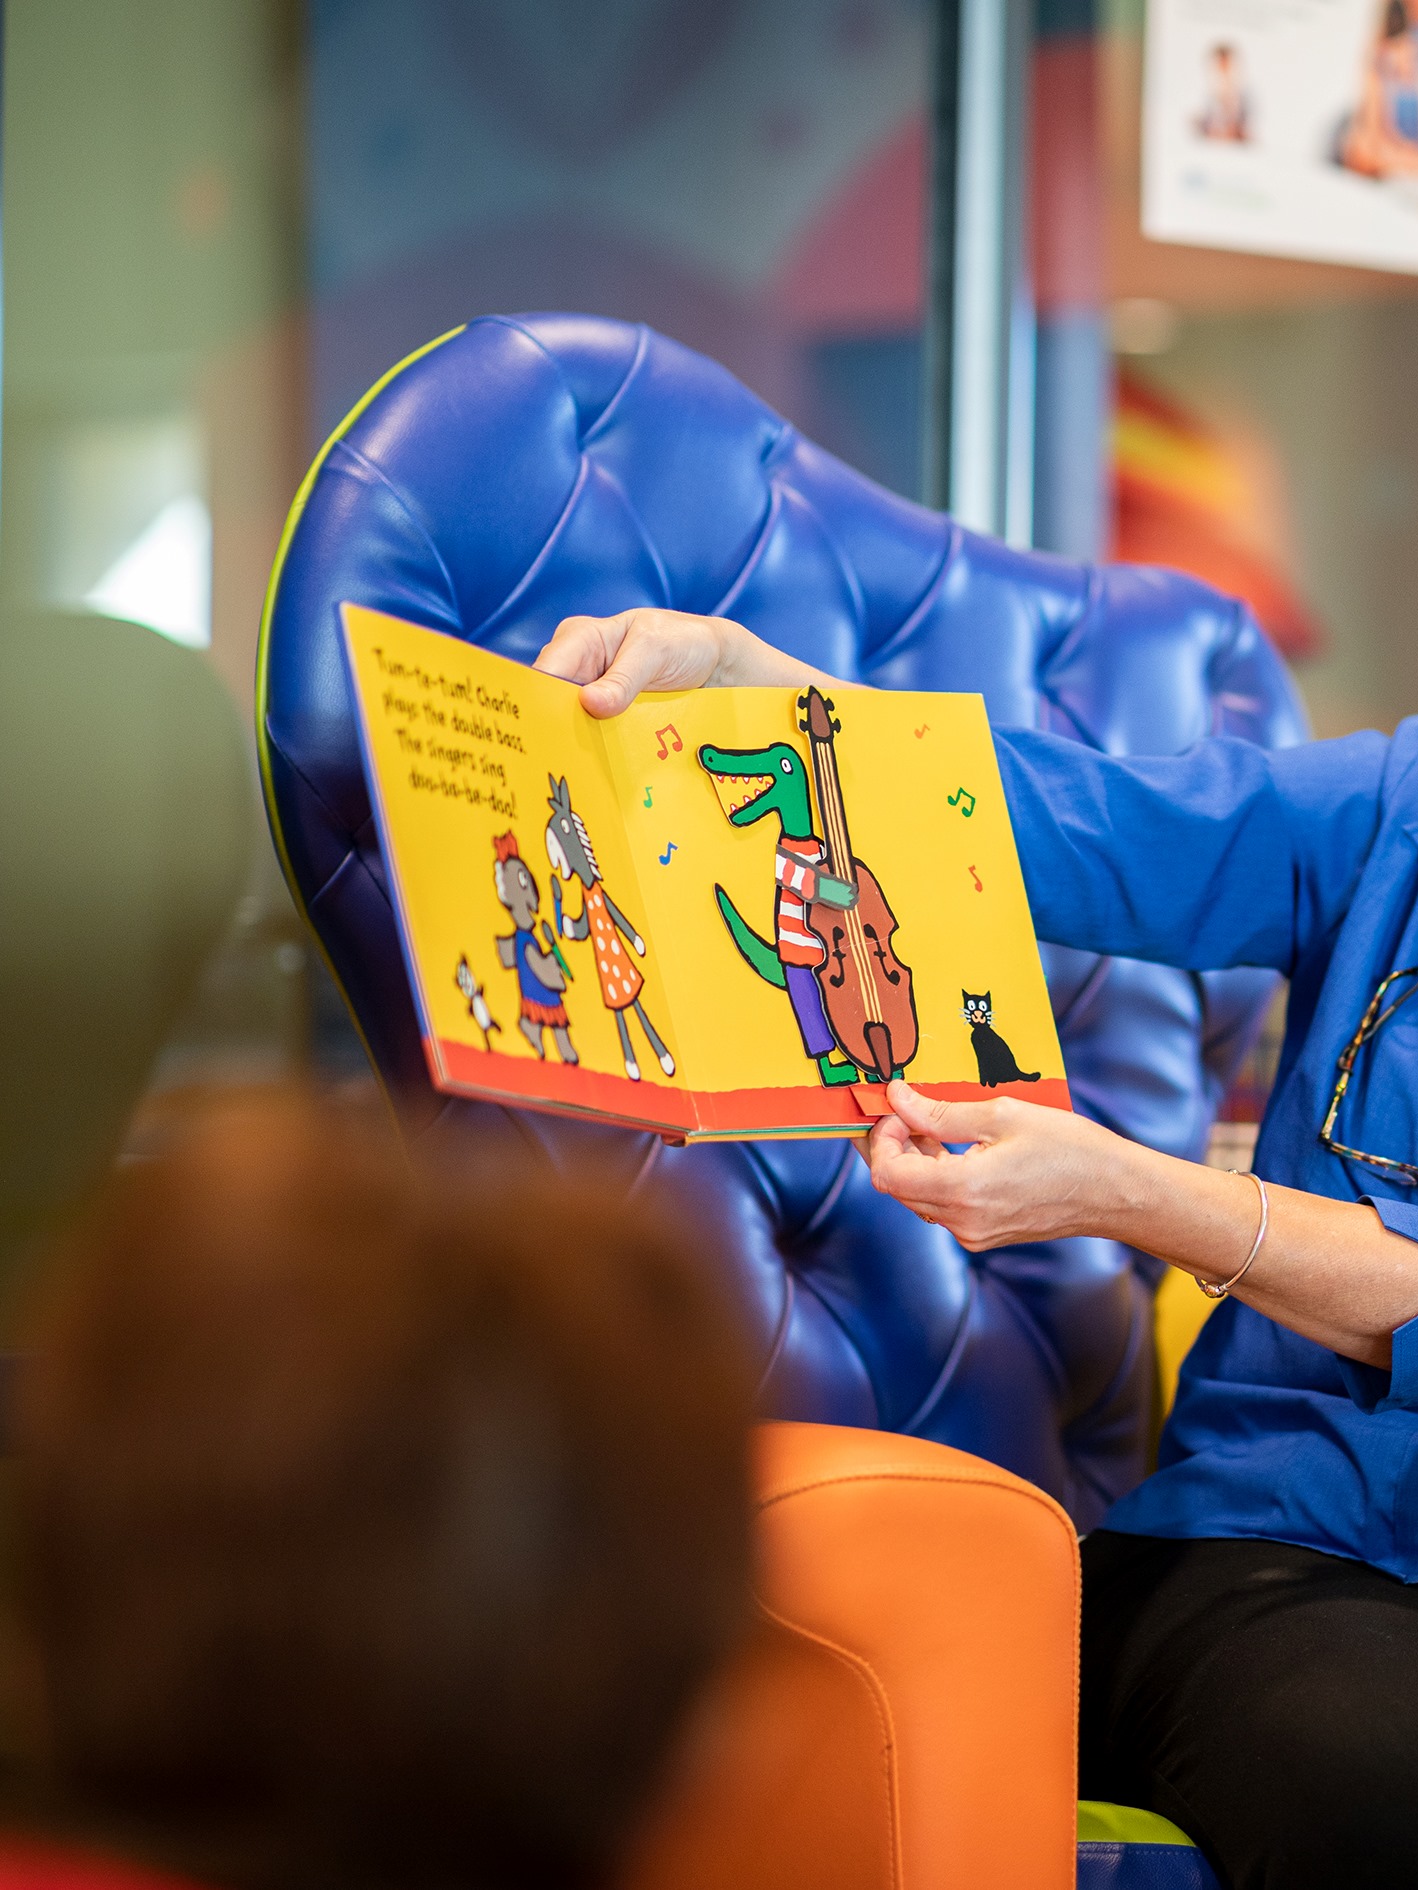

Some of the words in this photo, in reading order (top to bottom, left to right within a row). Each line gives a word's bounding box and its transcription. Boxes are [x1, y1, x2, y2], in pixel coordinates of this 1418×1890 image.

[371, 647, 473, 704] Tum-ta-tum!
[476, 686, 519, 720] Charlie
[382, 686, 418, 722] plays
[422, 701, 445, 728] the
[451, 707, 492, 743] double
[494, 721, 527, 755] bass.
[394, 727, 421, 755] The
[427, 737, 475, 772] singers
[480, 752, 507, 788] sing
